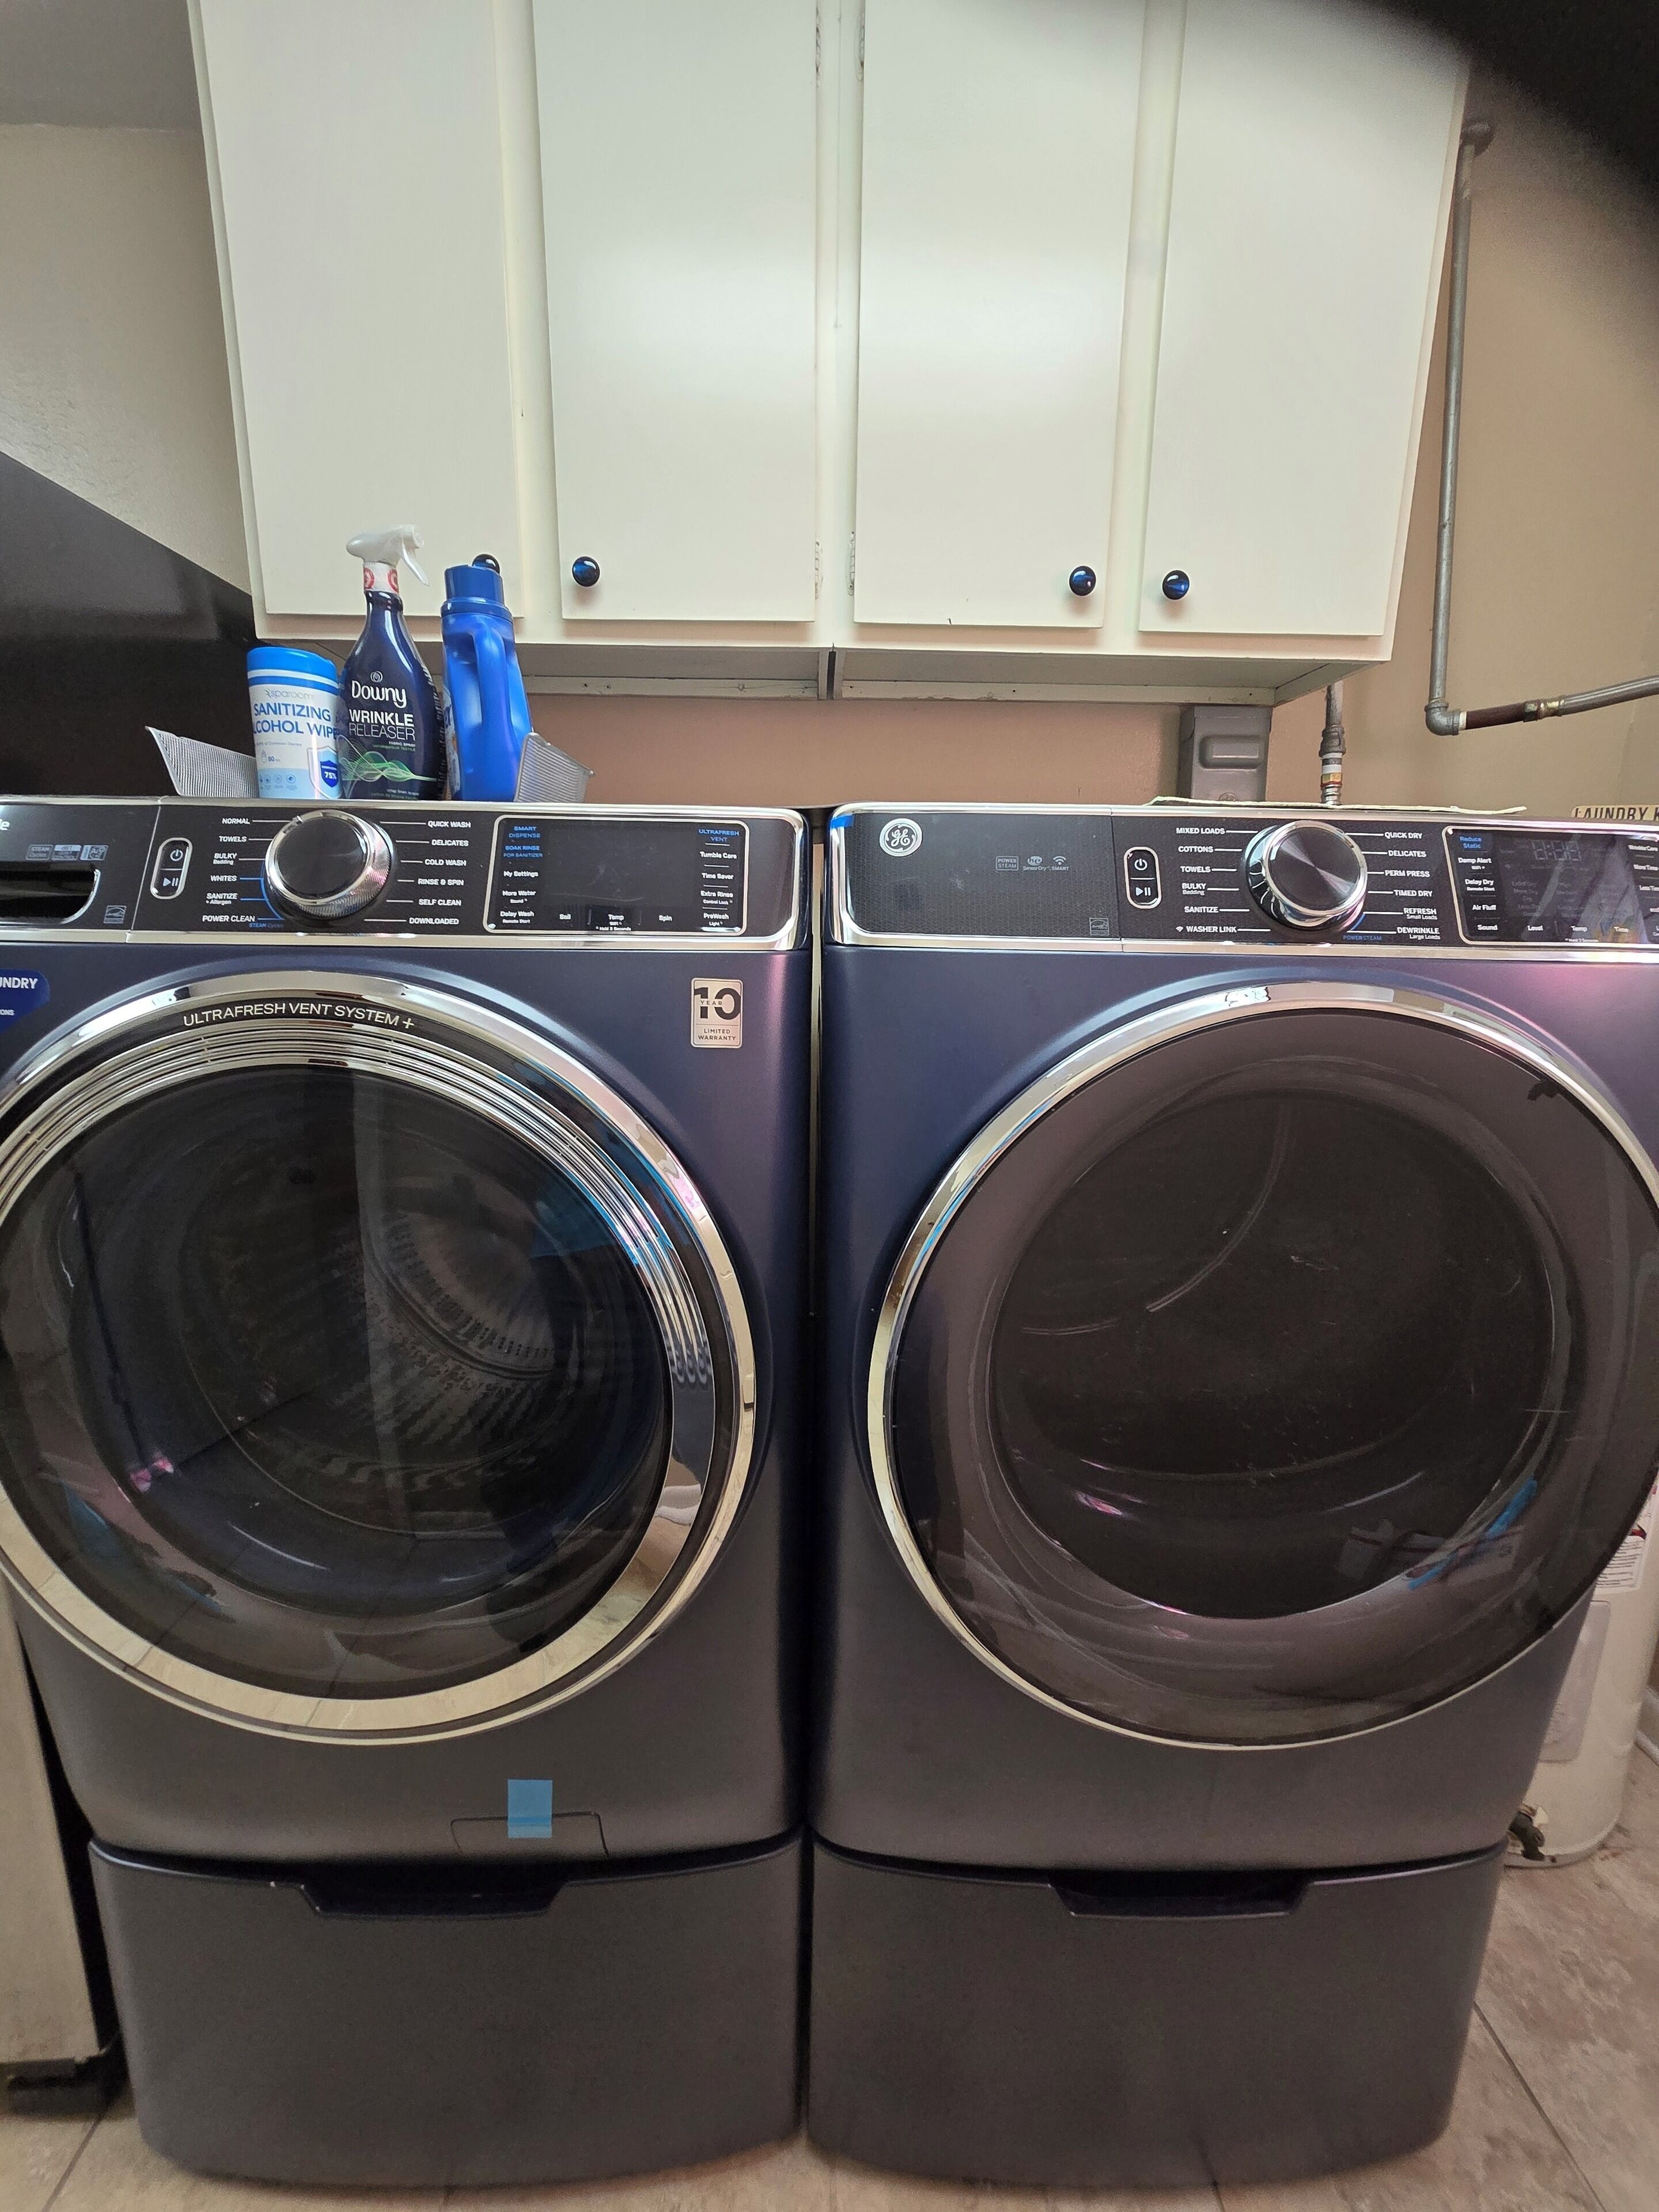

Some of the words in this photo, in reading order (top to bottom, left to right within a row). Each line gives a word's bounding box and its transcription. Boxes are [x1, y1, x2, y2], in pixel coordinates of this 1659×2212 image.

[351, 680, 407, 708] Downy
[254, 703, 331, 722] SANITIZING
[349, 709, 414, 727] WRINKLE
[253, 720, 304, 734] LCOHOL
[349, 723, 415, 741] RELEASER
[324, 771, 337, 779] 75%
[694, 987, 741, 1020] 10
[184, 1003, 285, 1027] ULTRAFRESH
[289, 1002, 332, 1015] VENT
[334, 1005, 399, 1025] SYSTEM
